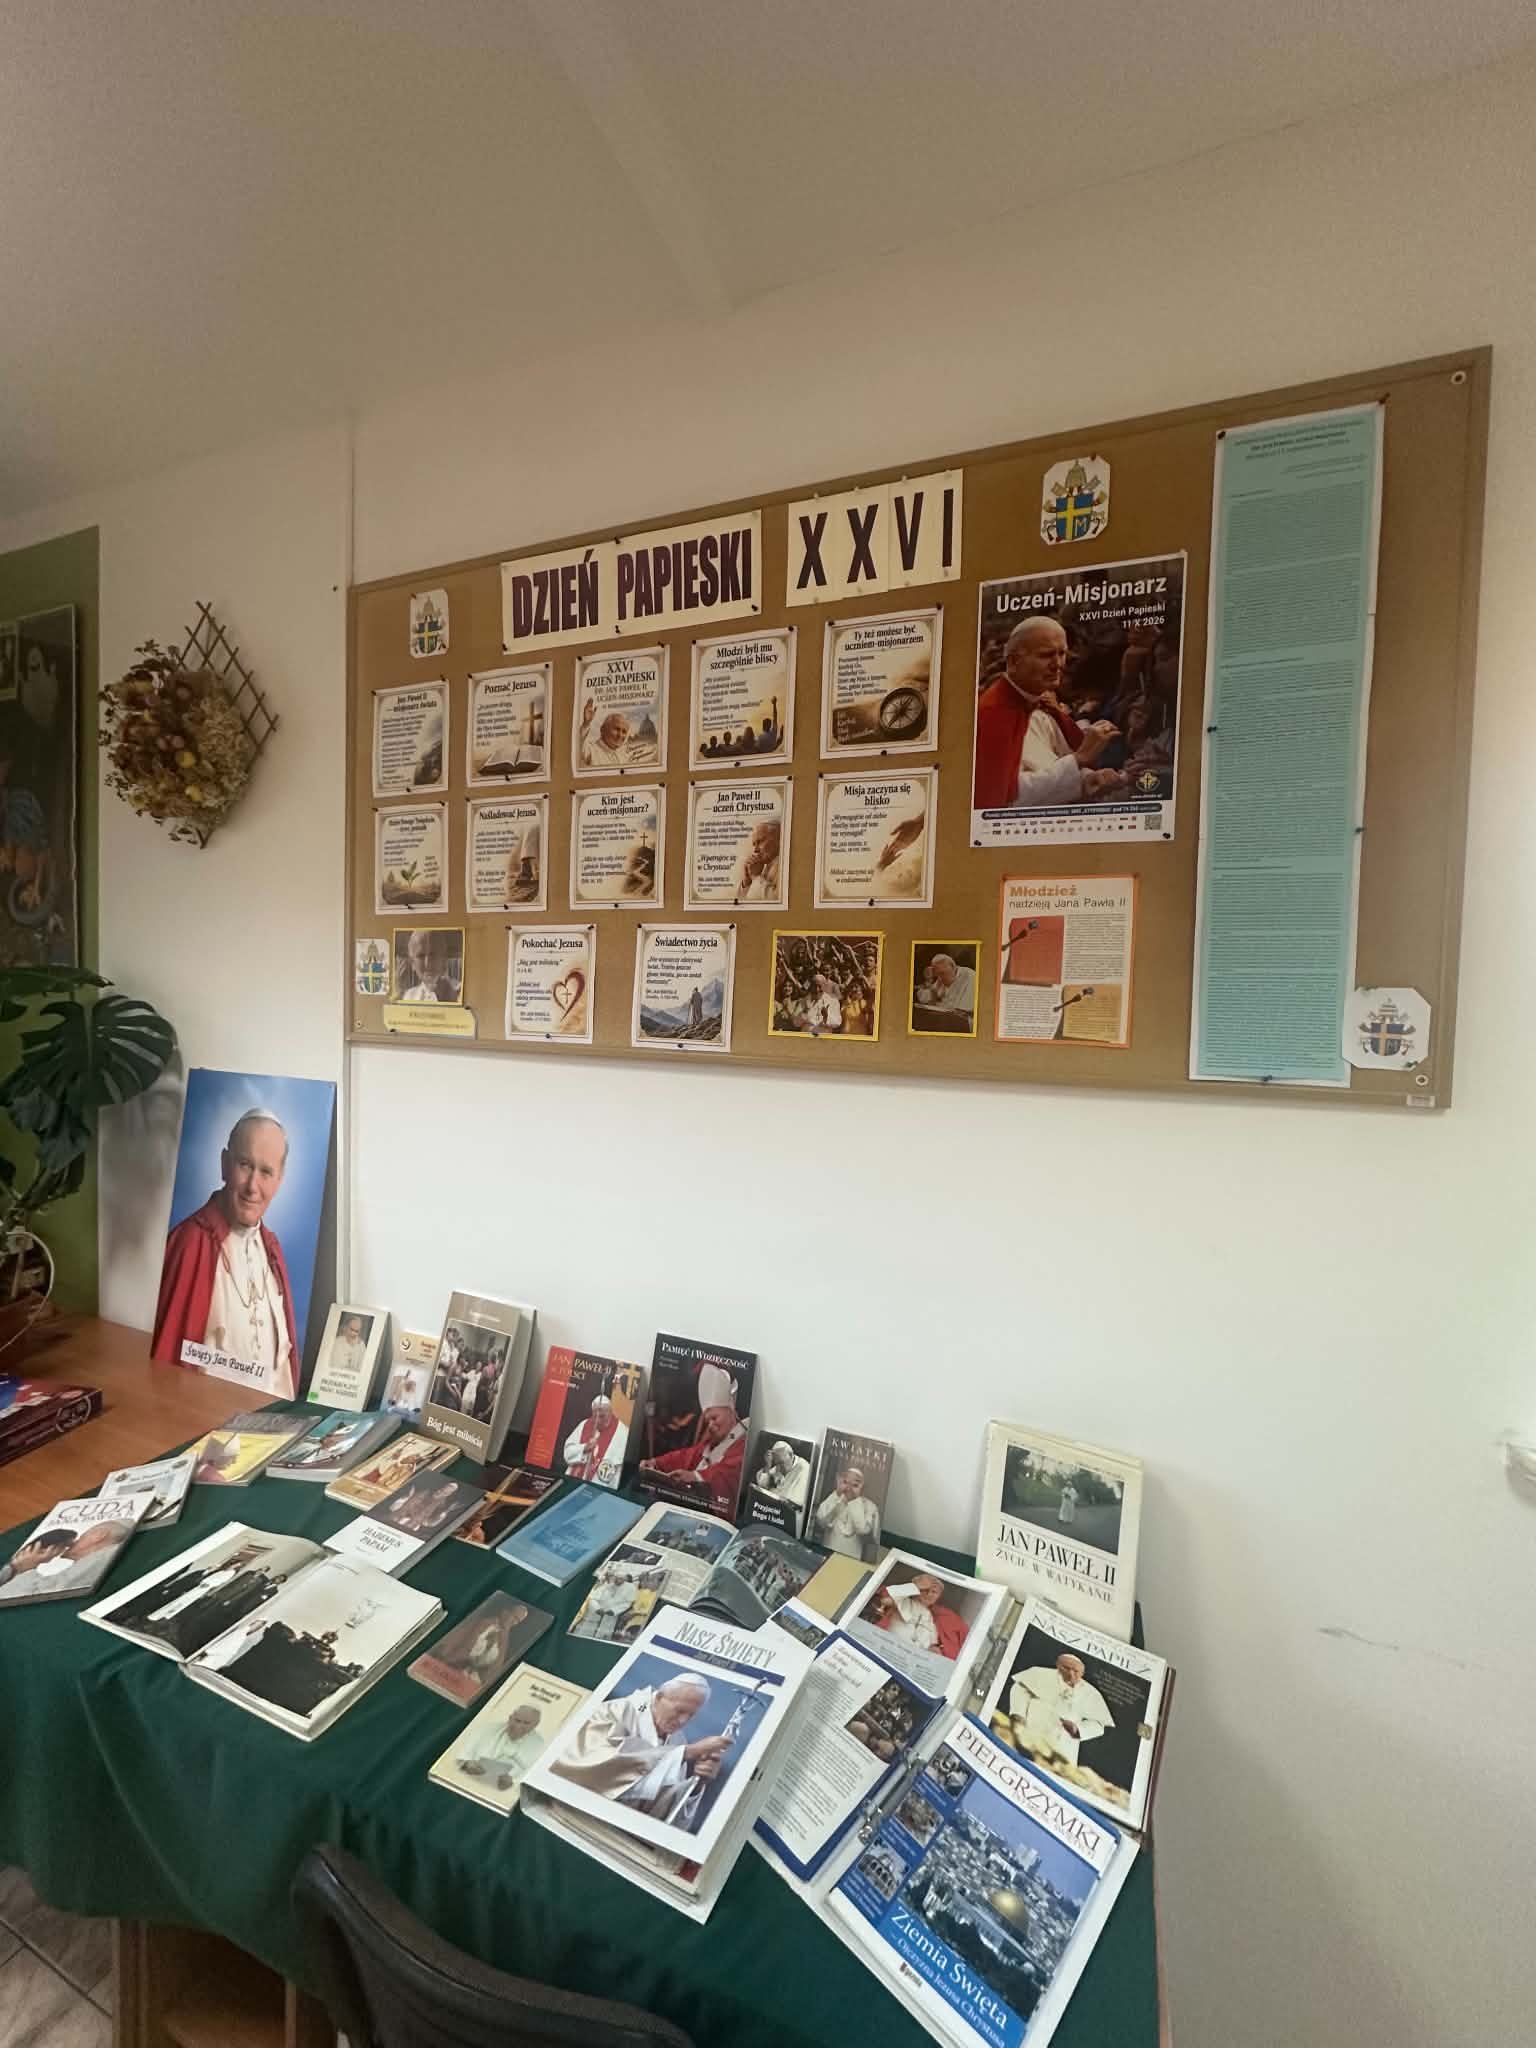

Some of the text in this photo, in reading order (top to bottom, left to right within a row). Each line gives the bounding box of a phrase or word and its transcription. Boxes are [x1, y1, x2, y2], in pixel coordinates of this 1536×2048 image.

[512, 548, 599, 638] DZIEŃ
[617, 528, 752, 621] PAPIESKI
[996, 576, 1167, 613] Uczeń-Misjonarz
[1080, 601, 1166, 621] XXVI Dzień Papieski
[1123, 615, 1165, 629] 11 X 2026
[854, 624, 916, 641] Ty też możesz być
[716, 643, 773, 658] Młodzi byli mu
[844, 635, 924, 652] uczniem-misjonarzem
[607, 660, 634, 673] XXVI
[710, 652, 779, 671] szczególnie bliscy
[484, 680, 537, 694] Poznać Jezusa
[586, 671, 656, 688] DZIEŃ PAPIESKI
[717, 791, 761, 802] Jan Paweł II
[844, 783, 912, 797] Misja zaczyna się
[601, 794, 635, 808] Kim jest
[712, 801, 774, 814] uczeń Chrystusa
[864, 795, 890, 806] blisko
[479, 808, 537, 820] Naśladować Jezusa
[587, 804, 649, 817] uczeń-misjonarz?
[1010, 884, 1078, 897] Młodzież
[1009, 897, 1126, 910] nadzieją Jana Pawła II
[521, 938, 583, 950] Pokochać Jezusa
[655, 935, 718, 949] Świadectwo życia
[661, 1341, 690, 1357] PAMIĘĆ
[185, 1344, 265, 1377] Święty Jan Paweł II
[574, 1358, 602, 1374] PAWEŁ
[427, 1416, 442, 1432] Bóg
[442, 1422, 457, 1437] jest
[832, 1437, 888, 1462] KWIATKI
[58, 1499, 135, 1519] CUDA
[359, 1535, 392, 1553] PAPAM
[998, 1524, 1116, 1586] JAN PAWEŁ II
[995, 1548, 1114, 1603] ŻYCIE W WATYKANIE
[674, 1620, 716, 1650] NASZ
[1031, 1614, 1081, 1644] NASZ
[956, 1727, 1101, 1852] PIELGRZYMKI
[891, 1905, 1008, 2031] Ziemia Święta
[934, 1973, 961, 2005] Jezusa
